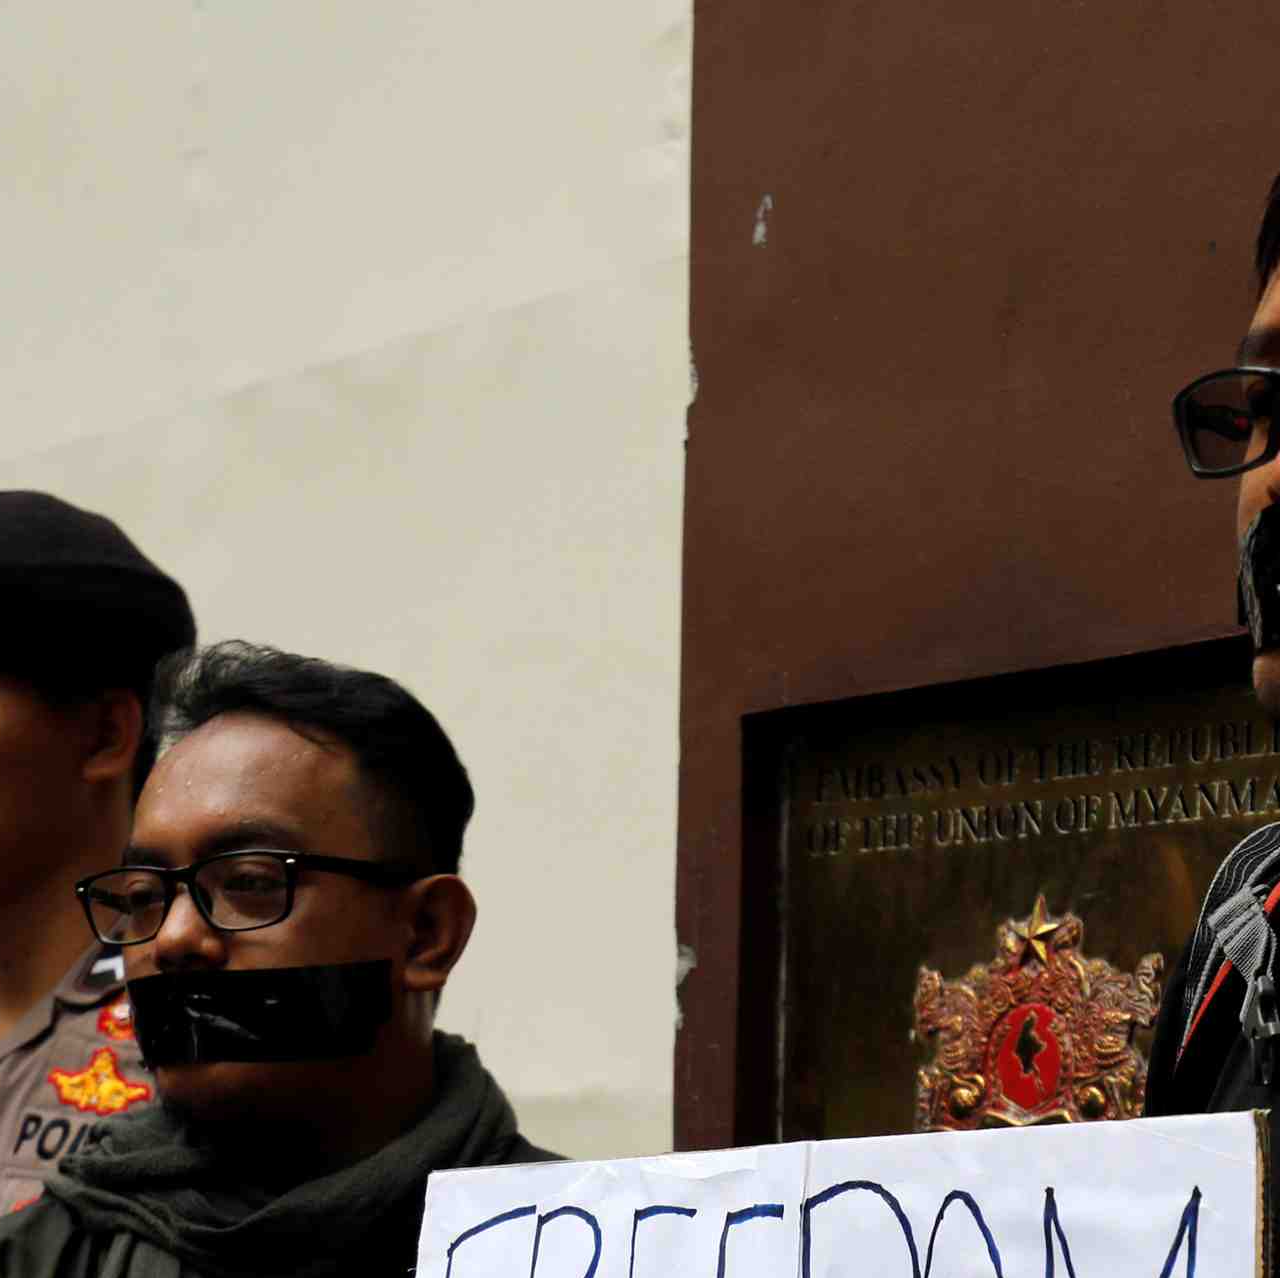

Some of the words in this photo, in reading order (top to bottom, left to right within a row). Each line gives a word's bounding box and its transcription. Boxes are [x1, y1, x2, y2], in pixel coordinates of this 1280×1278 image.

[976, 742, 1021, 788] OF
[1025, 732, 1104, 784] THE
[806, 812, 850, 858] OF
[853, 808, 928, 853] THE
[931, 798, 1043, 848] UNION
[1053, 790, 1104, 835] OF
